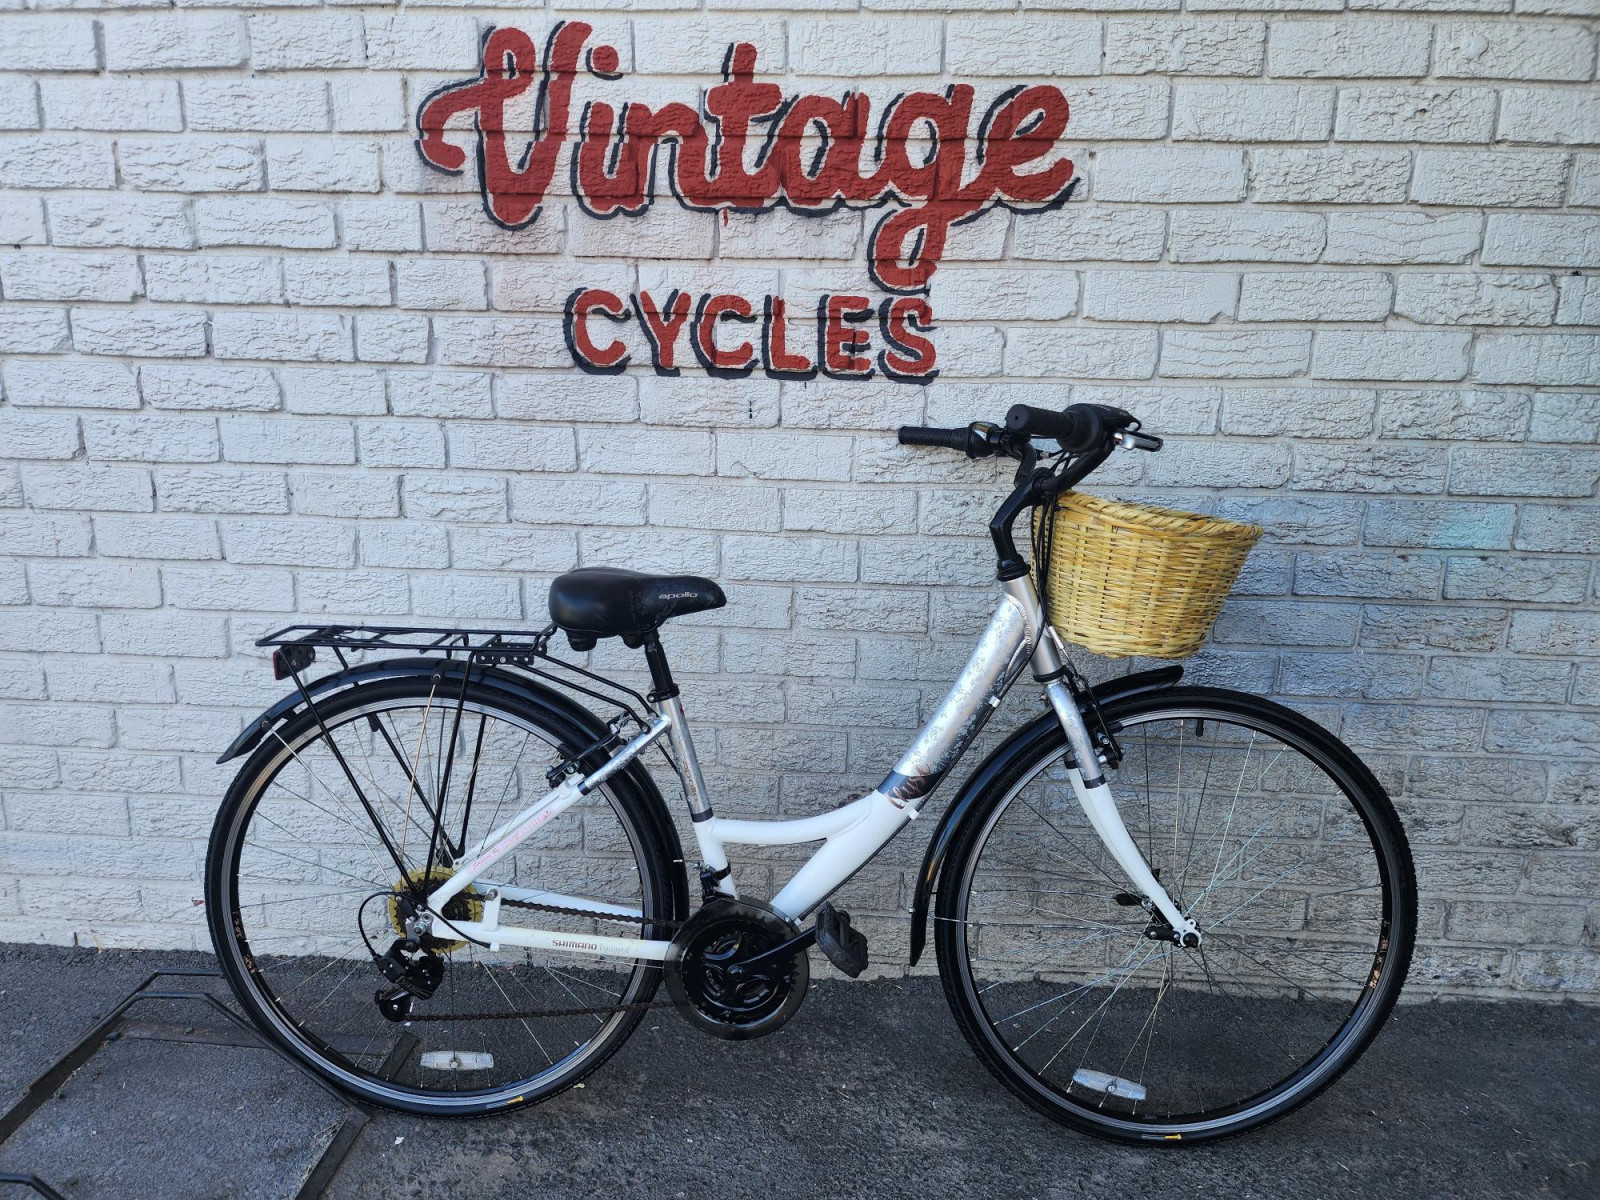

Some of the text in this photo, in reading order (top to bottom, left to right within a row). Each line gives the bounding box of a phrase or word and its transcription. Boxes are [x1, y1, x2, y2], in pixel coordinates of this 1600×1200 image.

[416, 20, 1081, 295] Vintage
[564, 288, 940, 385] CYCLES
[659, 591, 698, 600] apollo
[682, 759, 699, 801] apollo
[552, 939, 598, 951] SHIMANO
